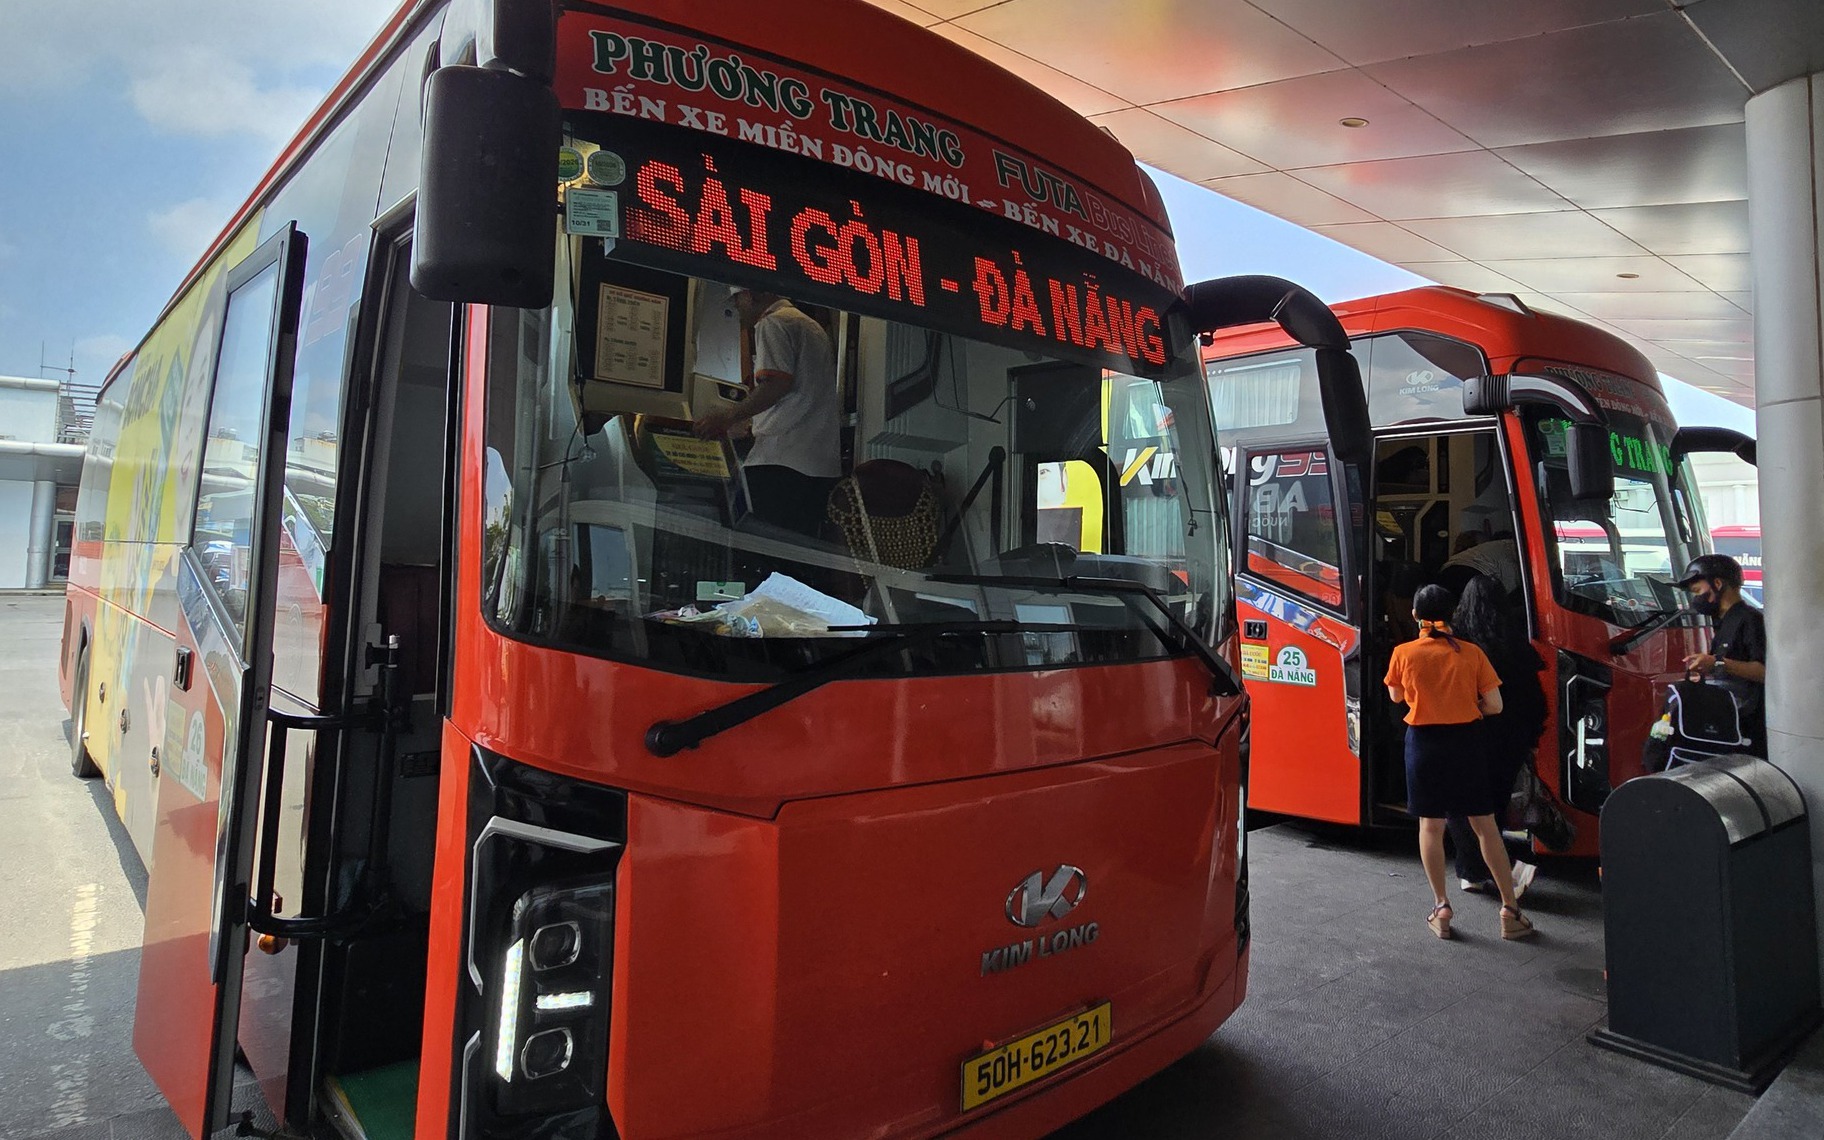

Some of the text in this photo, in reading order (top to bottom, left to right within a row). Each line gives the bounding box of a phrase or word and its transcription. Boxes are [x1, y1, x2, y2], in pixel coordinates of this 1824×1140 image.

[589, 29, 965, 169] PHƯƠNG TRANG
[583, 84, 666, 122] BẾN
[677, 104, 728, 136] XE
[737, 119, 823, 161] MIỀN
[832, 143, 915, 186] ĐÔNG
[1003, 199, 1059, 236] BẾN
[1066, 224, 1099, 253] XE
[1104, 241, 1135, 270] ĐÀ
[993, 149, 1090, 223] FUTA
[625, 153, 776, 270] SÀI
[791, 200, 925, 306] GÒN
[973, 250, 1047, 337] ĐÀ
[1416, 384, 1440, 394] LONG
[1271, 668, 1284, 680] ĐÀ
[1283, 650, 1301, 666] 25
[981, 922, 1101, 978] KIM LONG
[977, 1014, 1101, 1096] 50H-623.21
